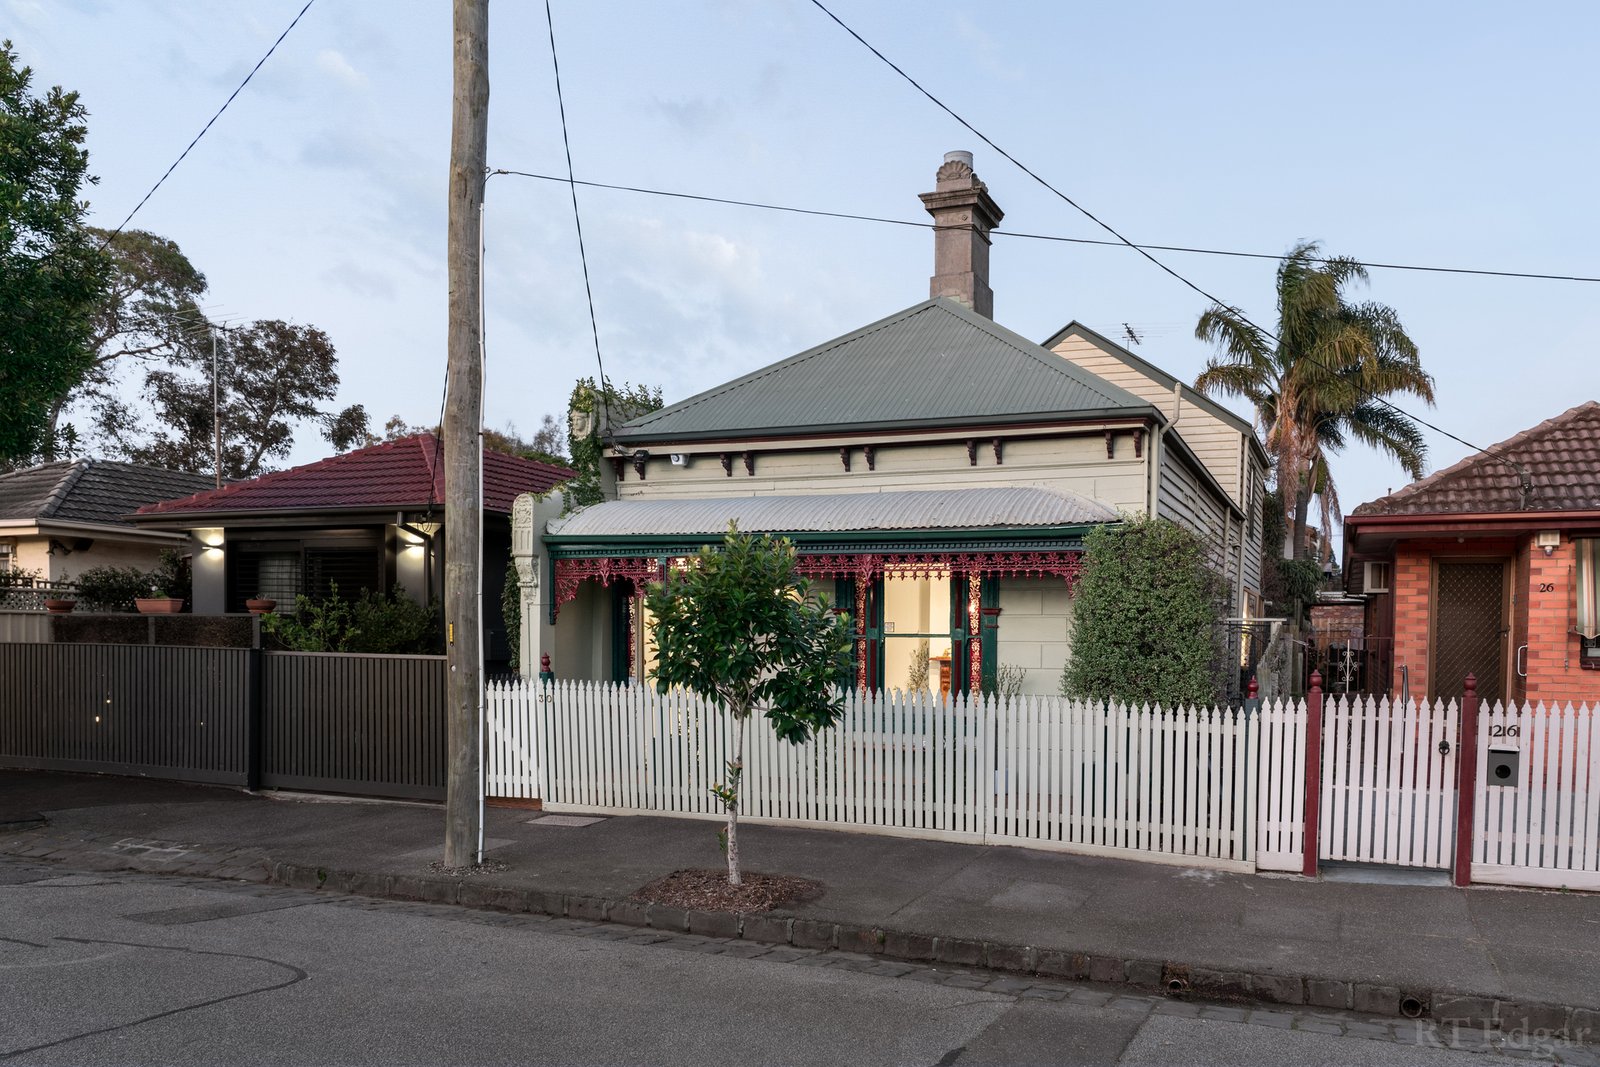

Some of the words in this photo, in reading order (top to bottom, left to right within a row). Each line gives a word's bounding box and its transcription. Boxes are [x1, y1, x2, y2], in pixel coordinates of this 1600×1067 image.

[1539, 582, 1555, 593] 26
[538, 694, 552, 703] 30
[1492, 724, 1518, 738] 26
